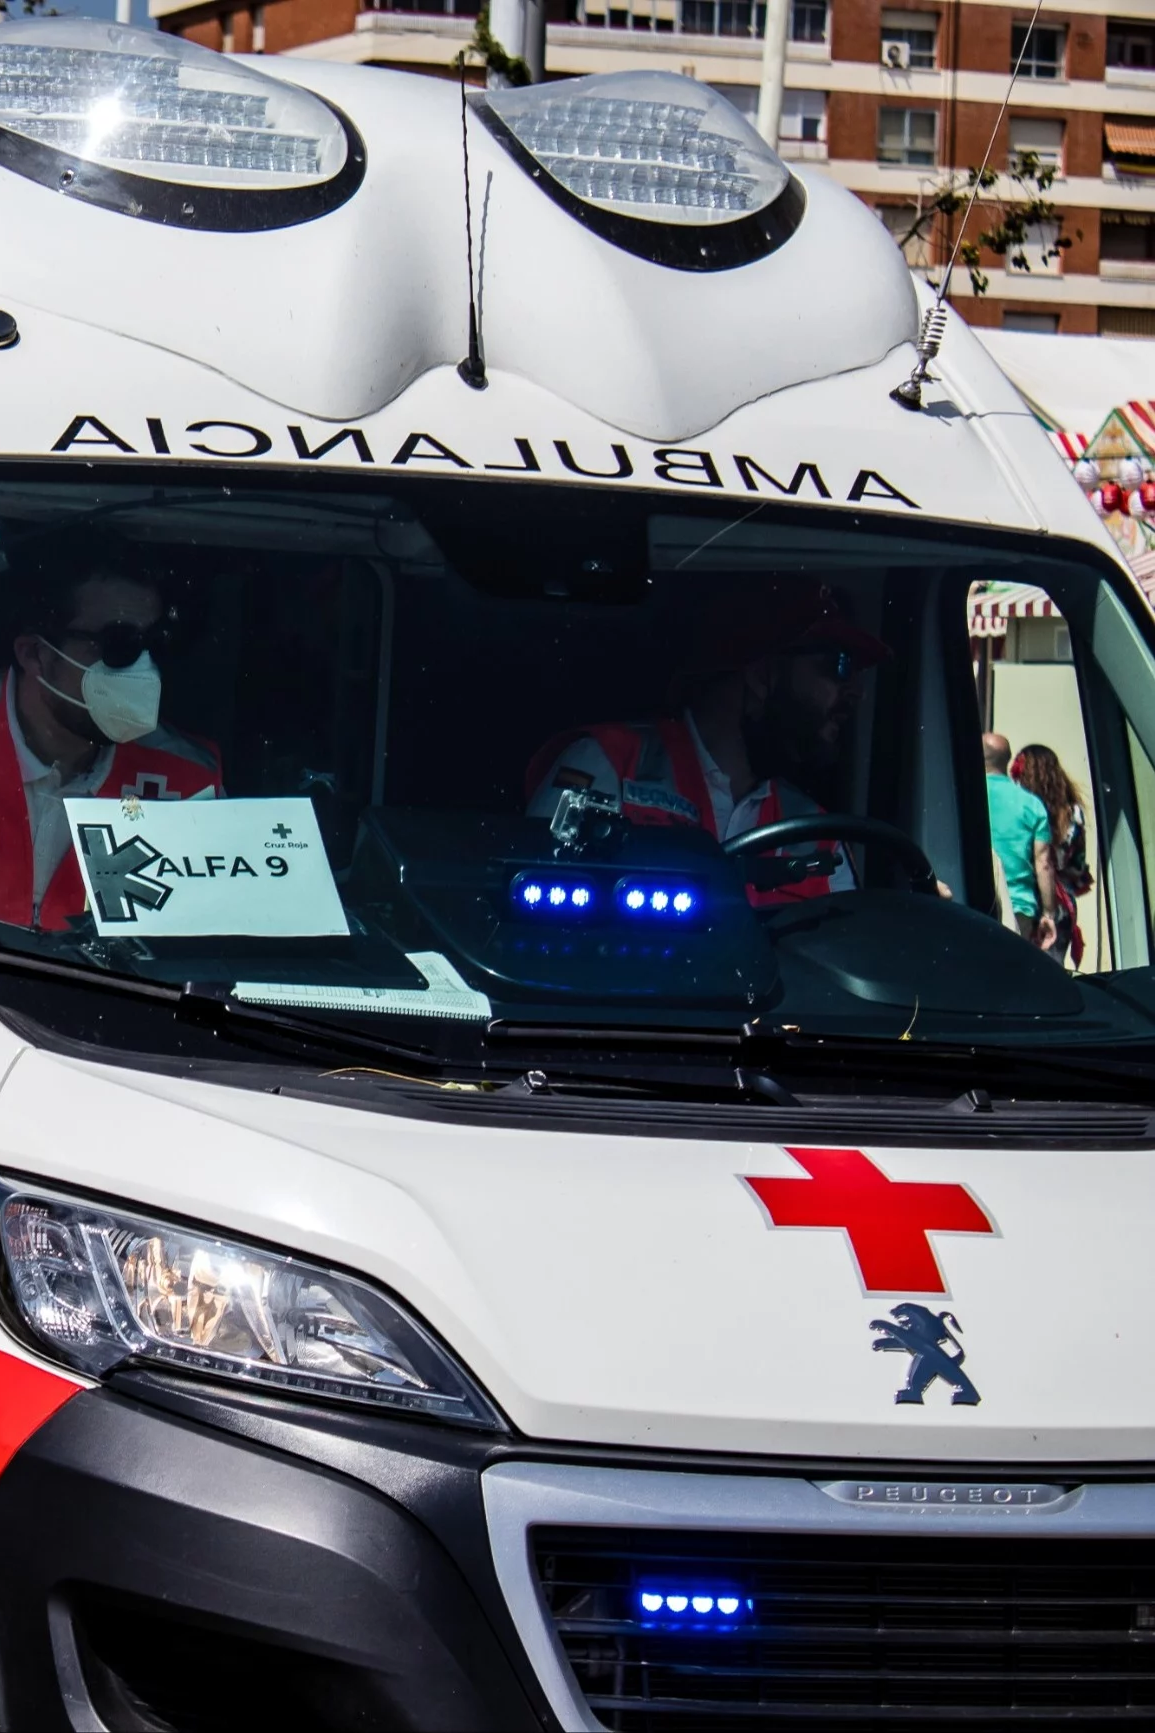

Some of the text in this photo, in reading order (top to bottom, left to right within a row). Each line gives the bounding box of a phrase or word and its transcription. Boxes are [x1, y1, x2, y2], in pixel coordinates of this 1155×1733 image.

[264, 841, 309, 850] Cruz Roja
[156, 855, 289, 878] ALFA 9
[856, 1485, 1038, 1504] PEUGEOT
